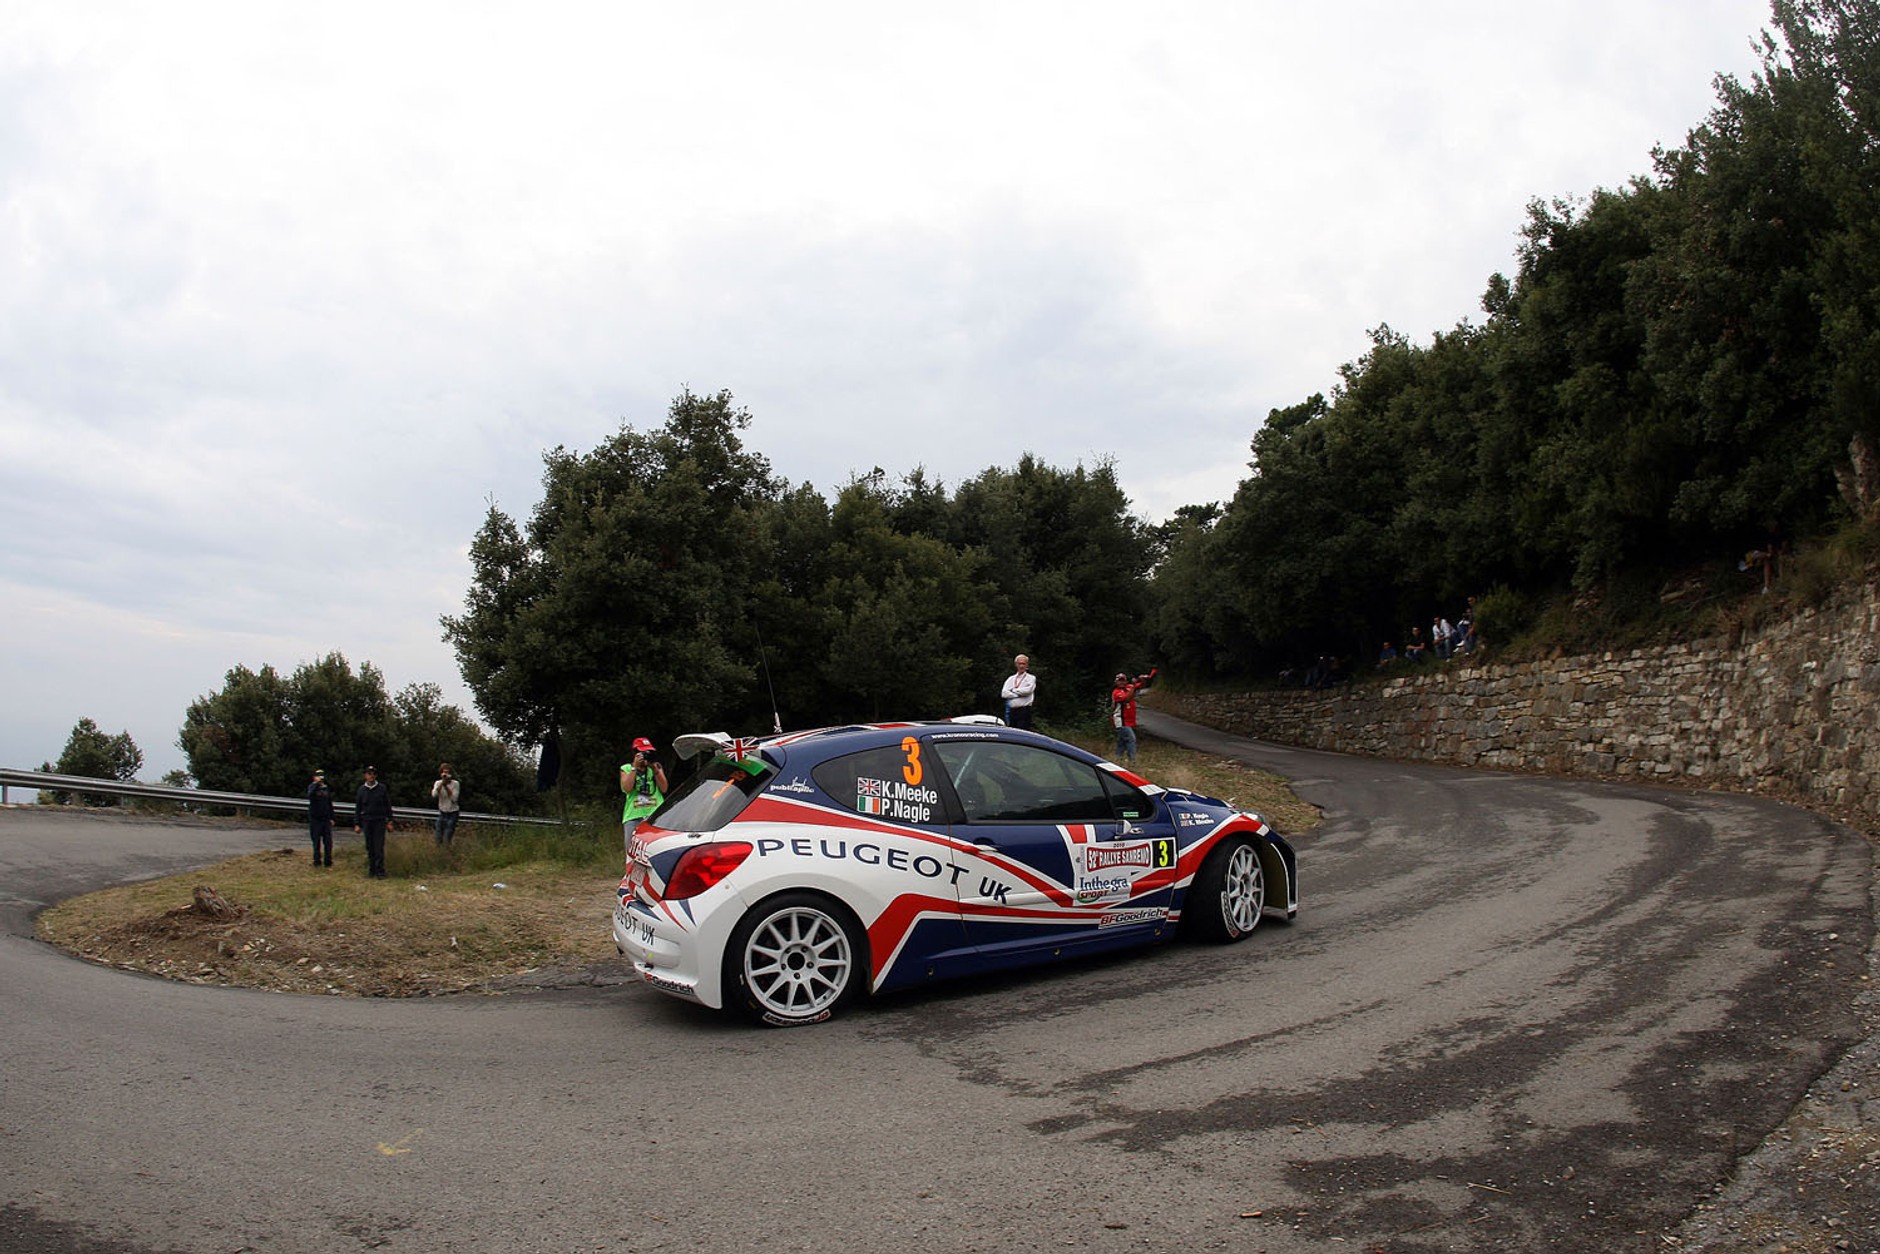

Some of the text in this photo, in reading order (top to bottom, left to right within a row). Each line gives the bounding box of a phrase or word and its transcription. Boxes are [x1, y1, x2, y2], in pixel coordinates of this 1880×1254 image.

[902, 736, 923, 786] 3
[881, 781, 938, 805] K.Meeke
[881, 799, 931, 823] P.Nagle
[1099, 850, 1122, 868] RALLYE
[1158, 840, 1169, 867] 3
[756, 838, 1013, 905] PEUGEOT UK
[1100, 908, 1163, 925] BFGoodrich
[641, 922, 656, 946] UK
